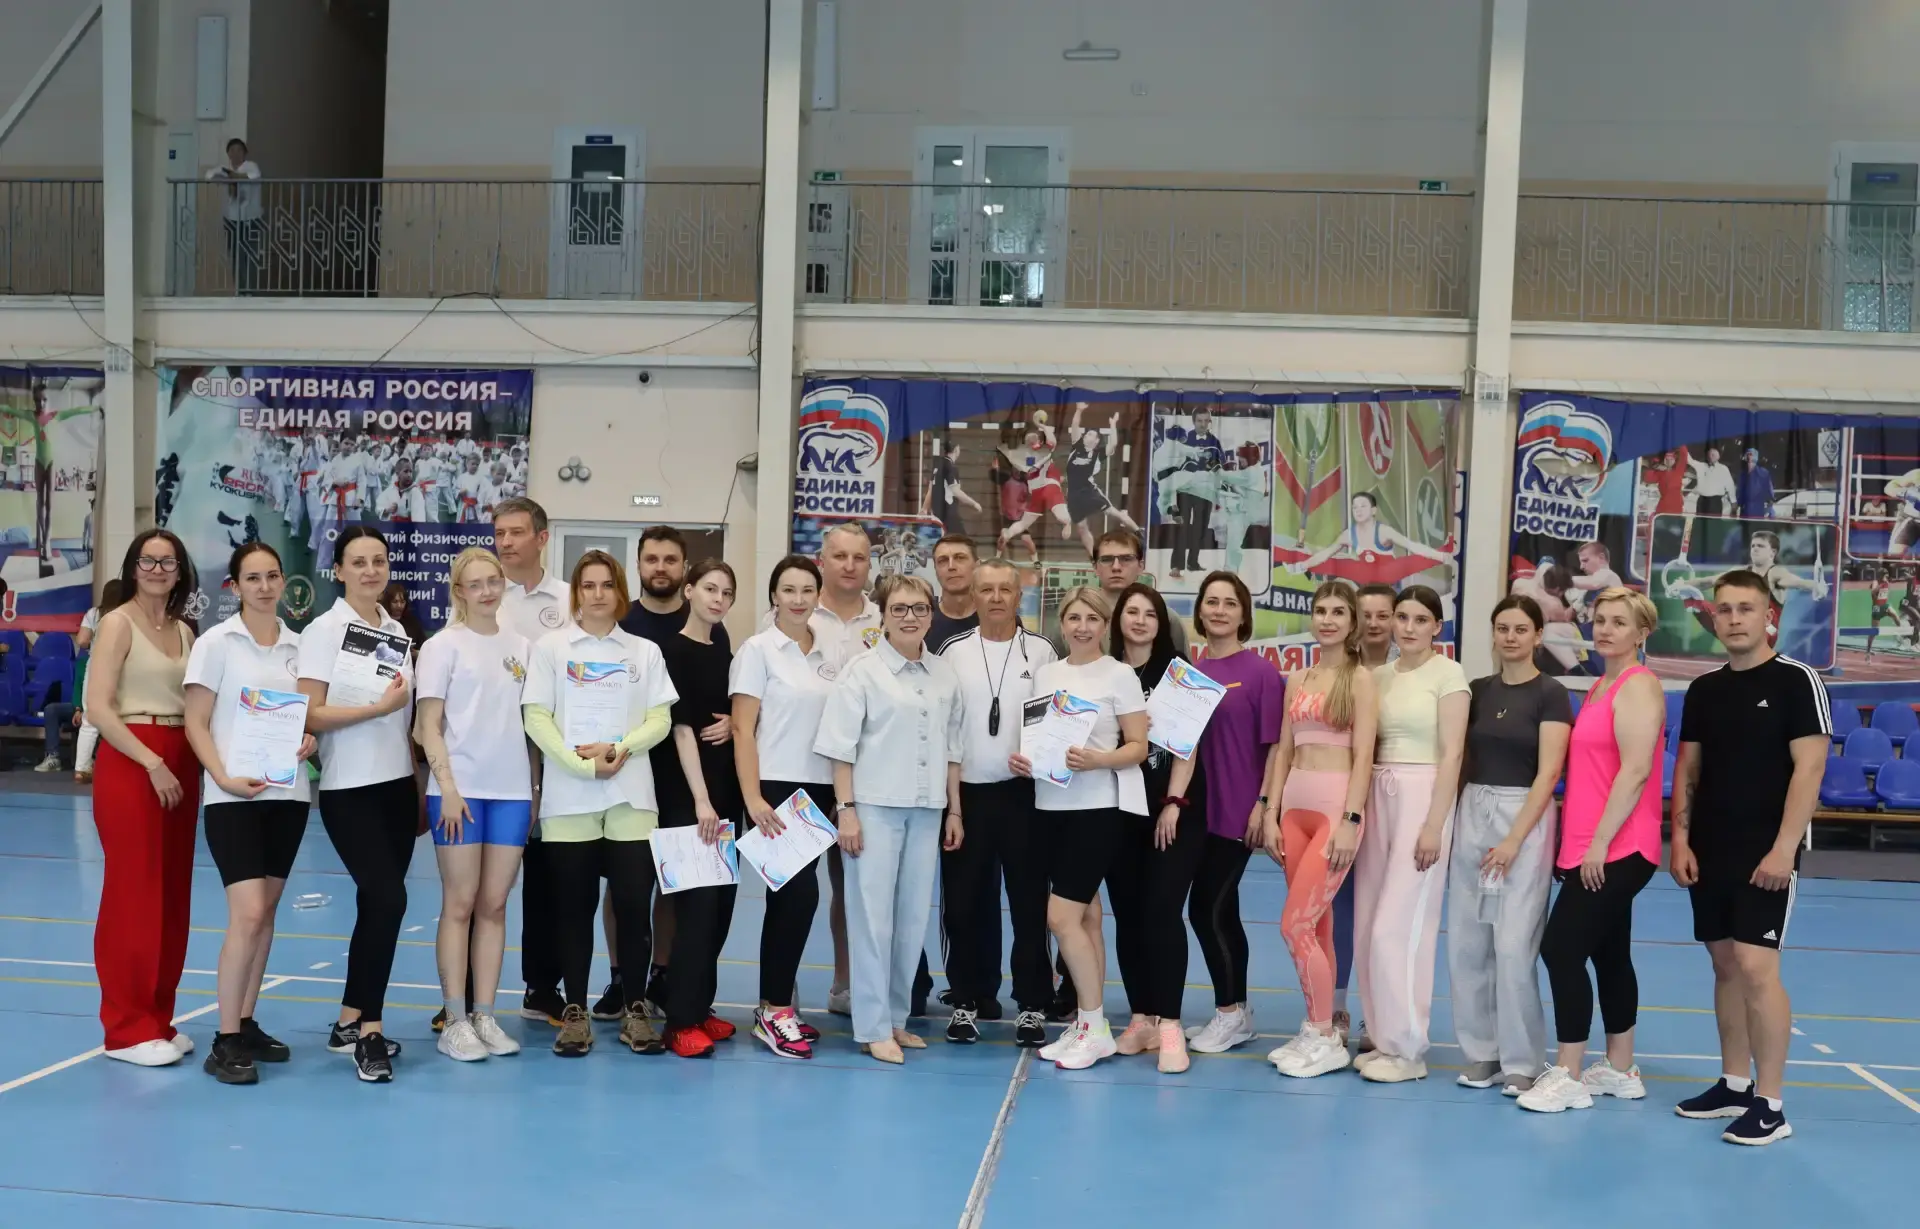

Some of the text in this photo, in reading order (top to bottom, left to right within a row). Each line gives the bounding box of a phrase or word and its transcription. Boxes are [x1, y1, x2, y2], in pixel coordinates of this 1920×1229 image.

[191, 377, 374, 398] СПОРТИВНАЯ
[239, 408, 472, 430] ЕДИНАЯ РОССИЯ
[795, 478, 875, 495] ЕДИНАЯ
[794, 495, 874, 514] РОССИЯ
[1518, 496, 1598, 521] ЕДИНАЯ
[1517, 515, 1595, 539] РОССИЯ
[410, 530, 495, 546] физическо
[349, 626, 391, 642] СЕРТИФИКАТ
